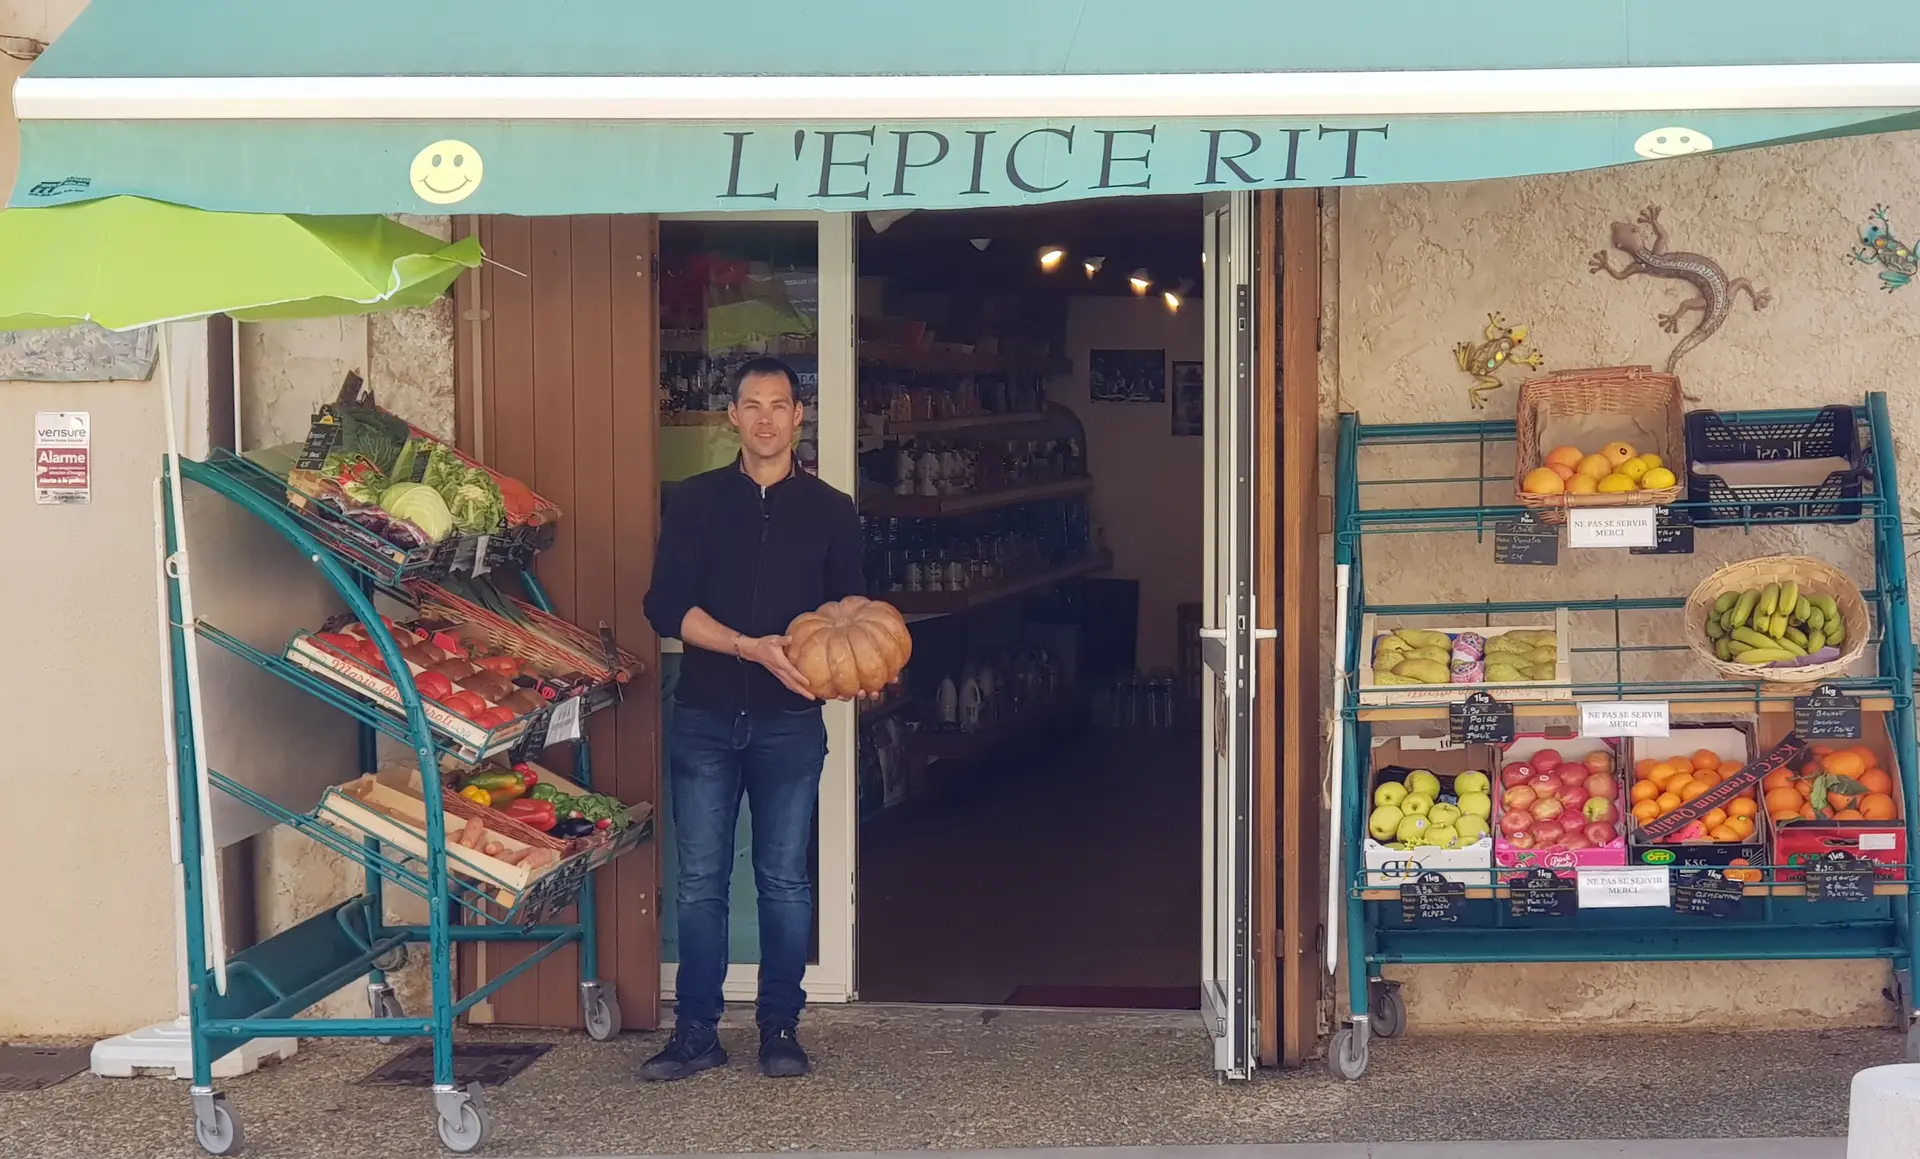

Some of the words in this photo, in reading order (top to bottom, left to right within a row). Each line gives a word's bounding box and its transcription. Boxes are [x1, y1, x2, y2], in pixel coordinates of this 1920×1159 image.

[1194, 123, 1389, 185] RIT
[38, 428, 86, 437] verisure
[38, 450, 86, 463] Alarme
[1616, 519, 1648, 527] SERVIR
[1596, 529, 1625, 537] MERCI
[331, 658, 376, 688] Mario
[1821, 686, 1836, 697] 1kg
[1474, 694, 1489, 703] 1kg
[1470, 715, 1499, 724] POIRE
[1631, 711, 1663, 719] SERVIR
[1609, 720, 1638, 728] MERCI
[1693, 772, 1756, 808] Premium
[1642, 807, 1697, 836] Quality
[1828, 851, 1845, 860] 1kg
[1537, 869, 1552, 878] 1kg
[1424, 874, 1440, 883] 1kg
